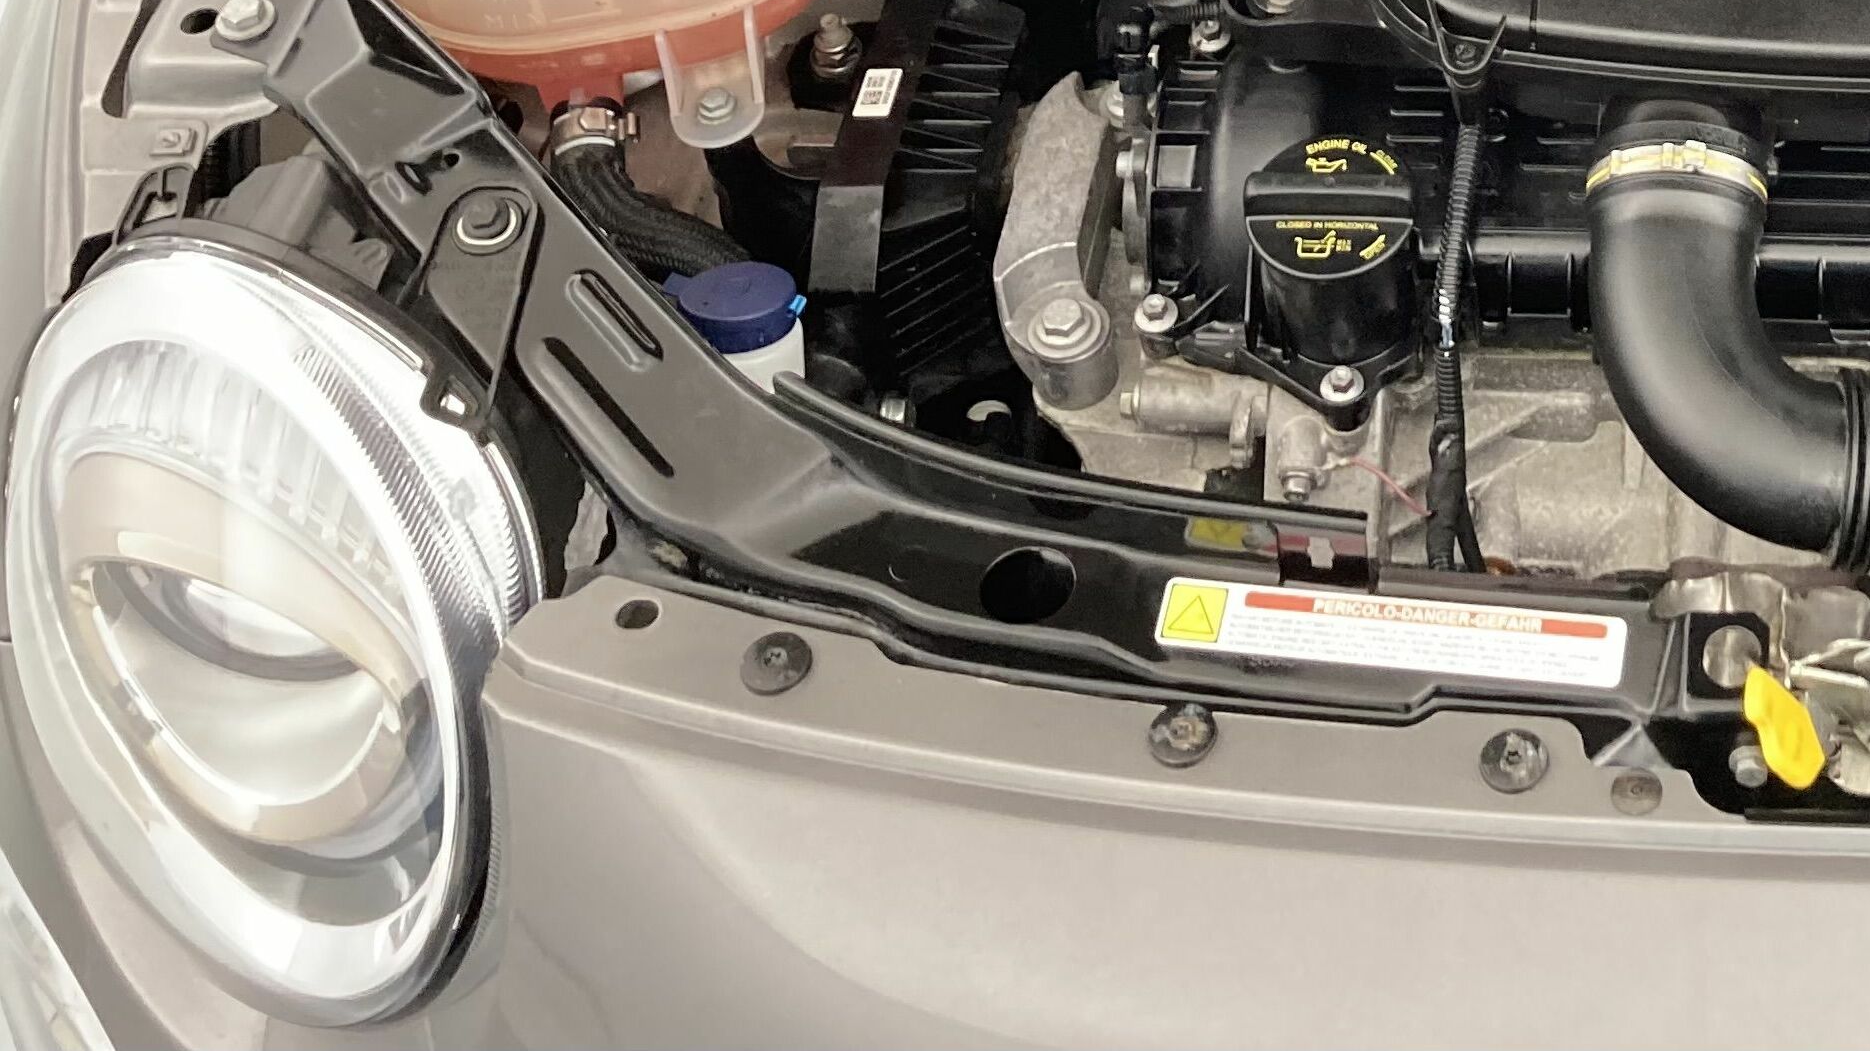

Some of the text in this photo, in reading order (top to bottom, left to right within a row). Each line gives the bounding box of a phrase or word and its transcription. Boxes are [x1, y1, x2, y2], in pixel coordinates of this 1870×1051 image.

[1305, 138, 1368, 155] ENGINE OIL
[1275, 220, 1379, 231] CLOSED IN HORIZONTAL
